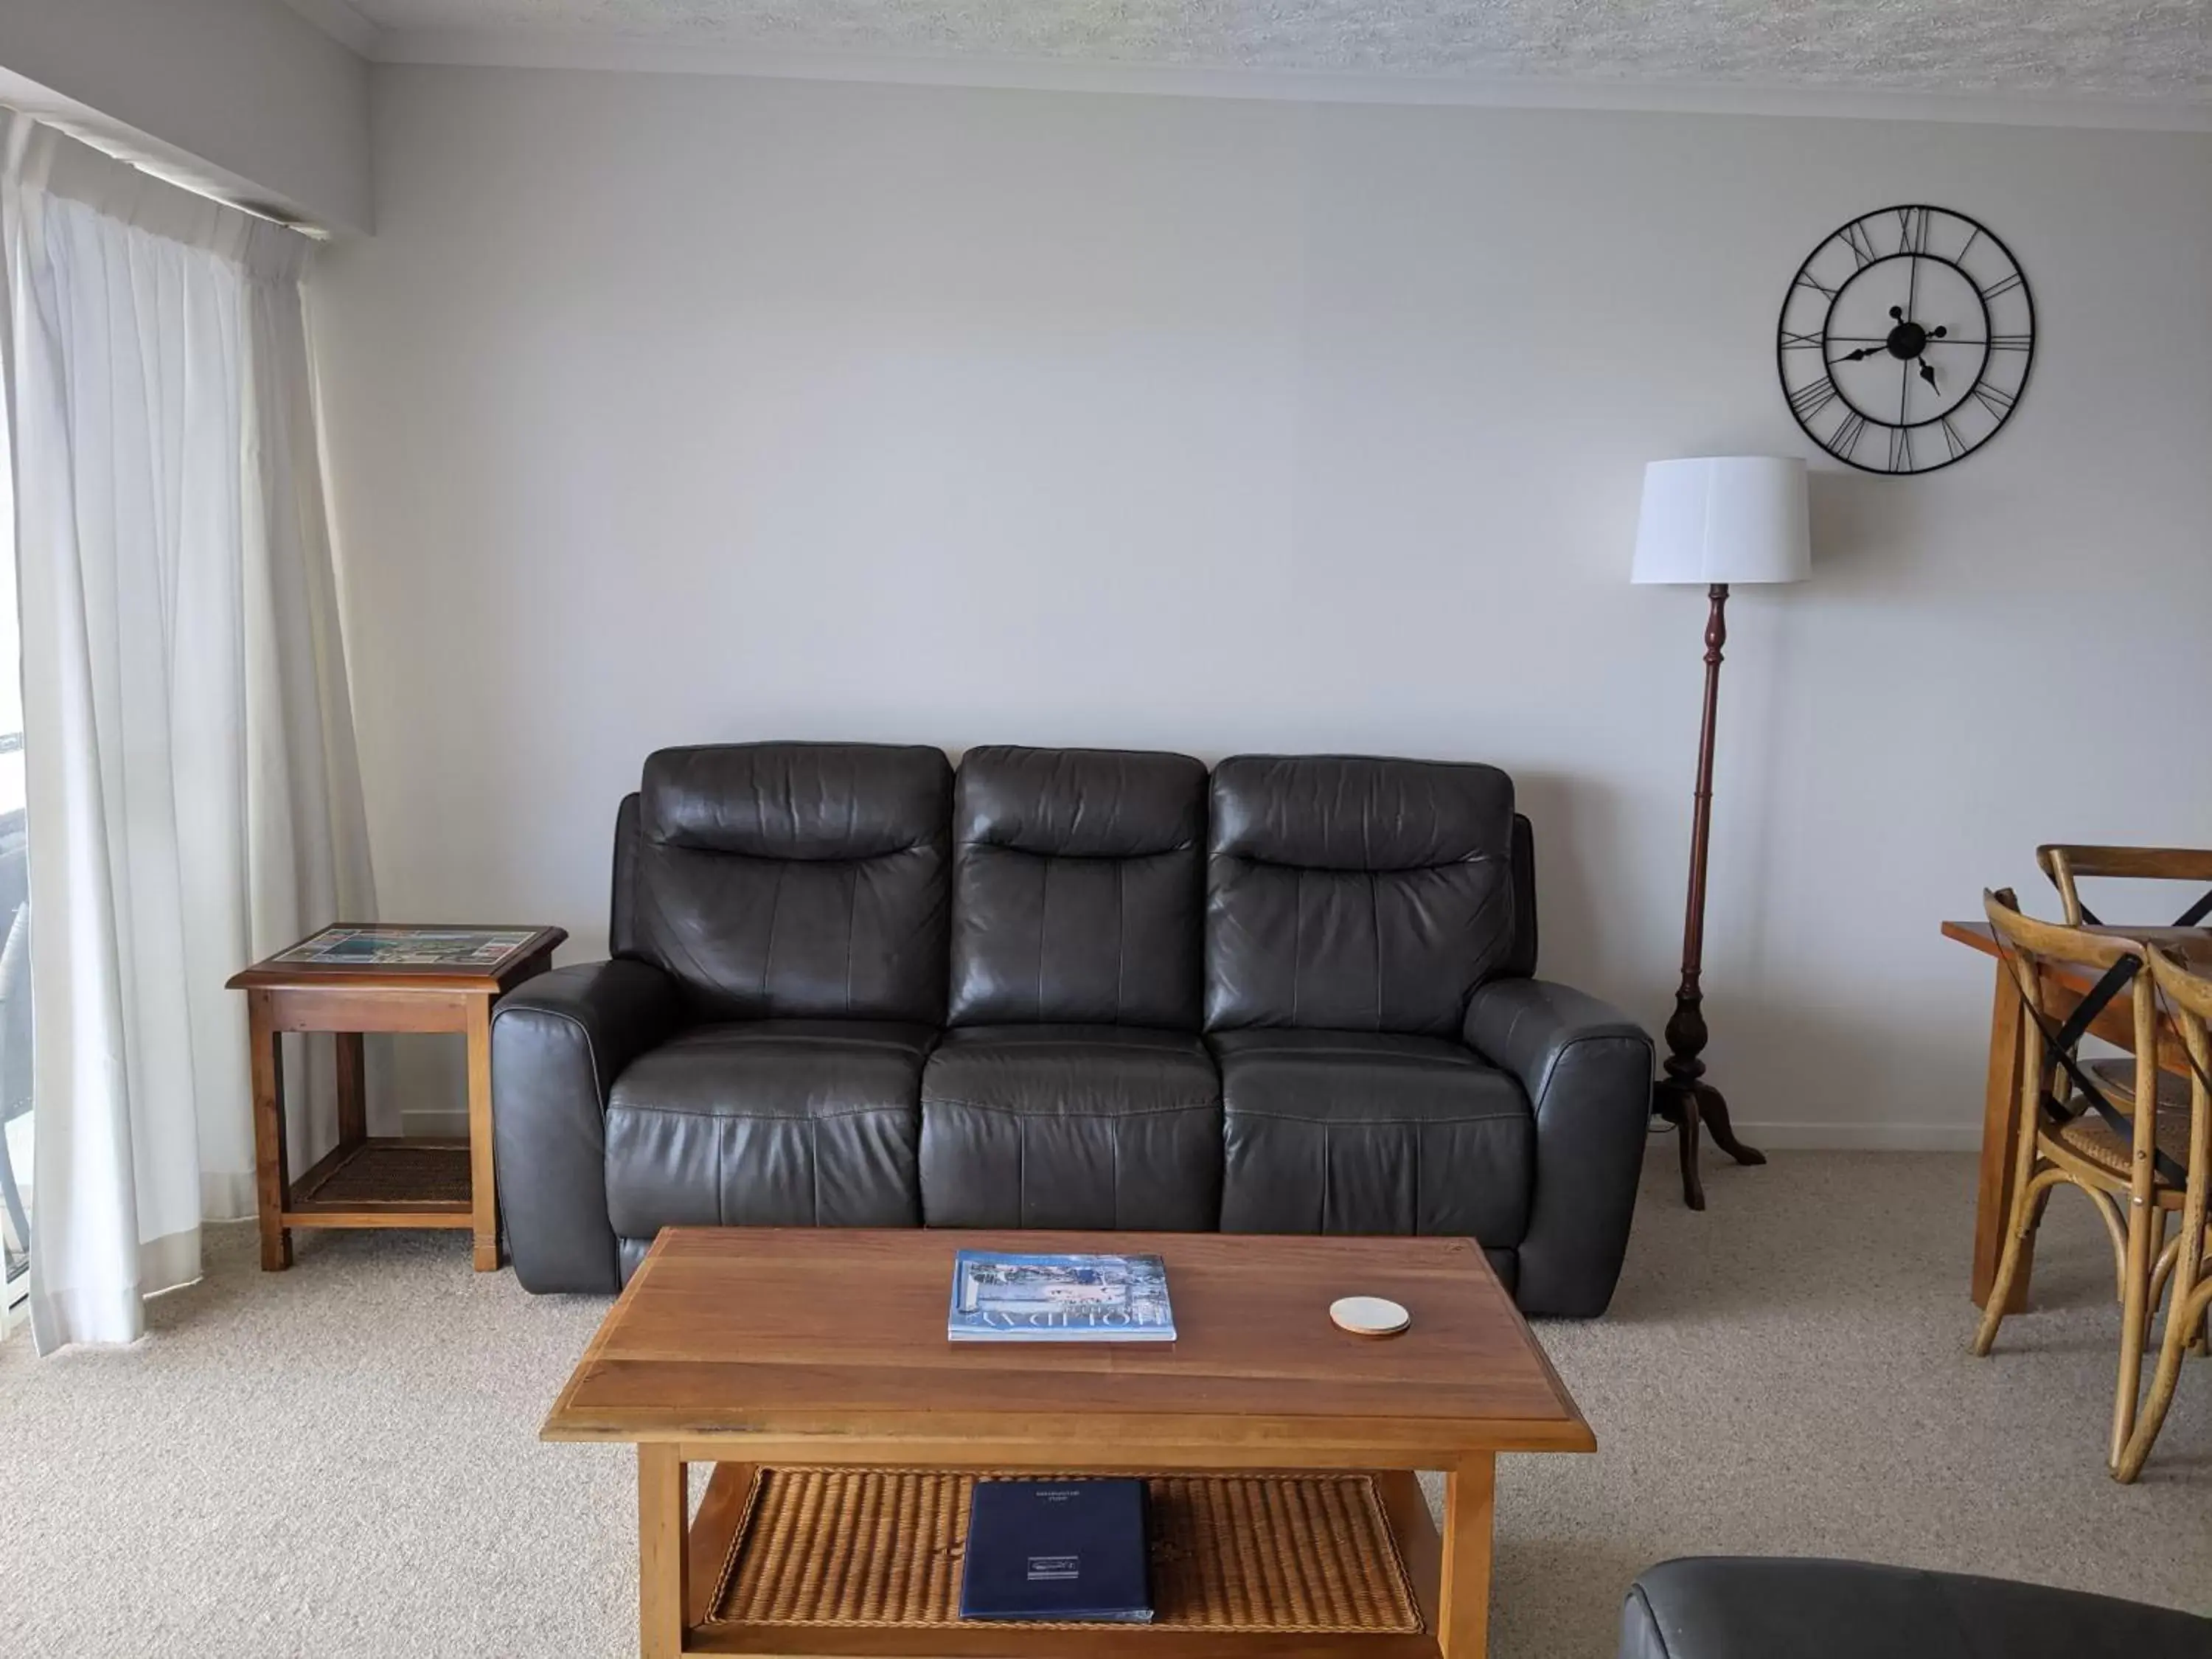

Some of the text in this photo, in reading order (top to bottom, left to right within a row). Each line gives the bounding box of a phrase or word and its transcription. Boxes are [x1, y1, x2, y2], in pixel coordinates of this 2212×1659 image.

[1838, 220, 1877, 271] XI
[1898, 208, 1930, 254] XII
[1796, 271, 1837, 302] X
[1982, 272, 2023, 302] II
[1781, 330, 1823, 349] IX
[1990, 335, 2031, 351] III
[1790, 375, 1837, 424] VIII
[1972, 380, 2016, 422] IV
[1828, 411, 1865, 461] VII
[1889, 427, 1913, 473] VI
[1942, 417, 1967, 459] V
